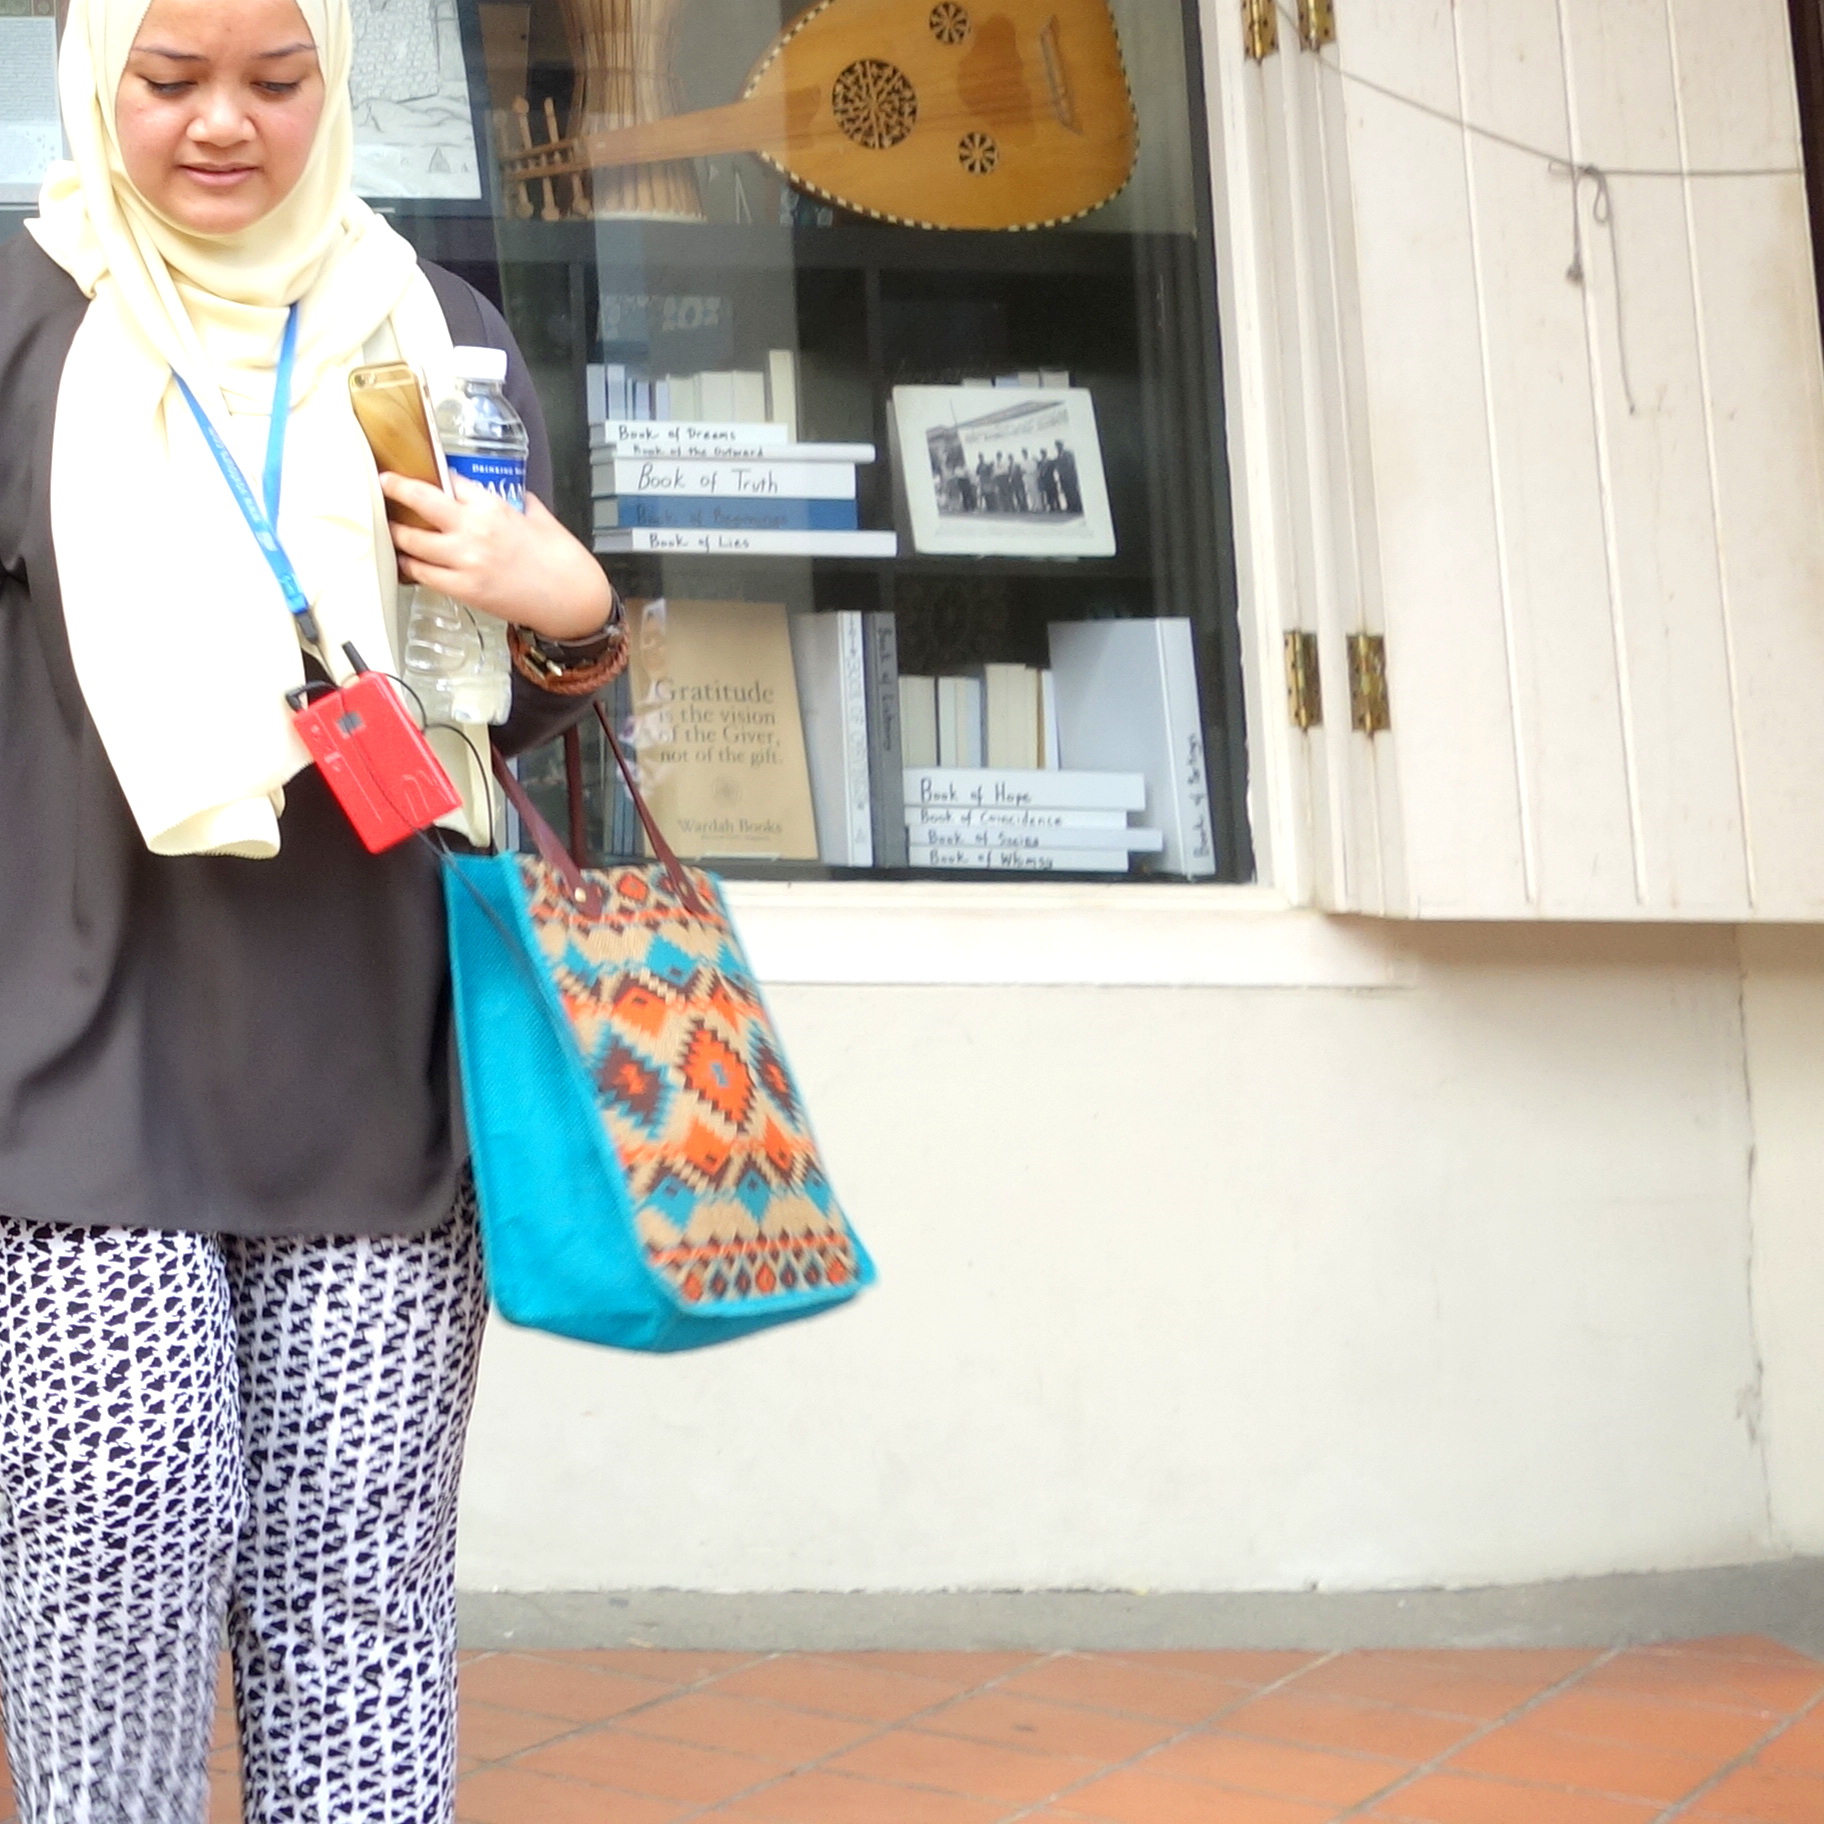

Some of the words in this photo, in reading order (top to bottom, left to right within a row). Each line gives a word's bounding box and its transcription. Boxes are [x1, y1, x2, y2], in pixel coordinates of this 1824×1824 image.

[619, 425, 659, 440] Book
[668, 427, 680, 442] of
[688, 427, 736, 441] Dreams
[670, 446, 681, 457] of
[688, 446, 707, 457] the
[638, 462, 686, 491] Book
[700, 470, 717, 493] of
[731, 468, 778, 494] Truth
[649, 533, 688, 548] Book
[698, 535, 709, 553] of
[718, 535, 750, 549] Lies
[655, 679, 775, 704] Gratitude
[681, 704, 714, 723] the
[720, 707, 776, 725] vision
[685, 725, 716, 743] the
[723, 726, 781, 747] Giver,
[660, 749, 690, 763] not
[695, 747, 713, 763] of
[718, 747, 745, 763] the
[750, 748, 783, 768] gift.
[920, 777, 956, 802] Book
[970, 784, 983, 807] of
[995, 781, 1031, 806] Hope
[677, 818, 734, 833] Wardah
[739, 818, 783, 833] Books
[920, 809, 953, 823] Book
[961, 809, 971, 826] of
[980, 809, 1062, 826] Coincidence
[928, 830, 963, 845] Book
[975, 831, 987, 847] of
[930, 850, 969, 865] Book
[978, 850, 991, 869] of
[1001, 851, 1054, 870] Whimsy
